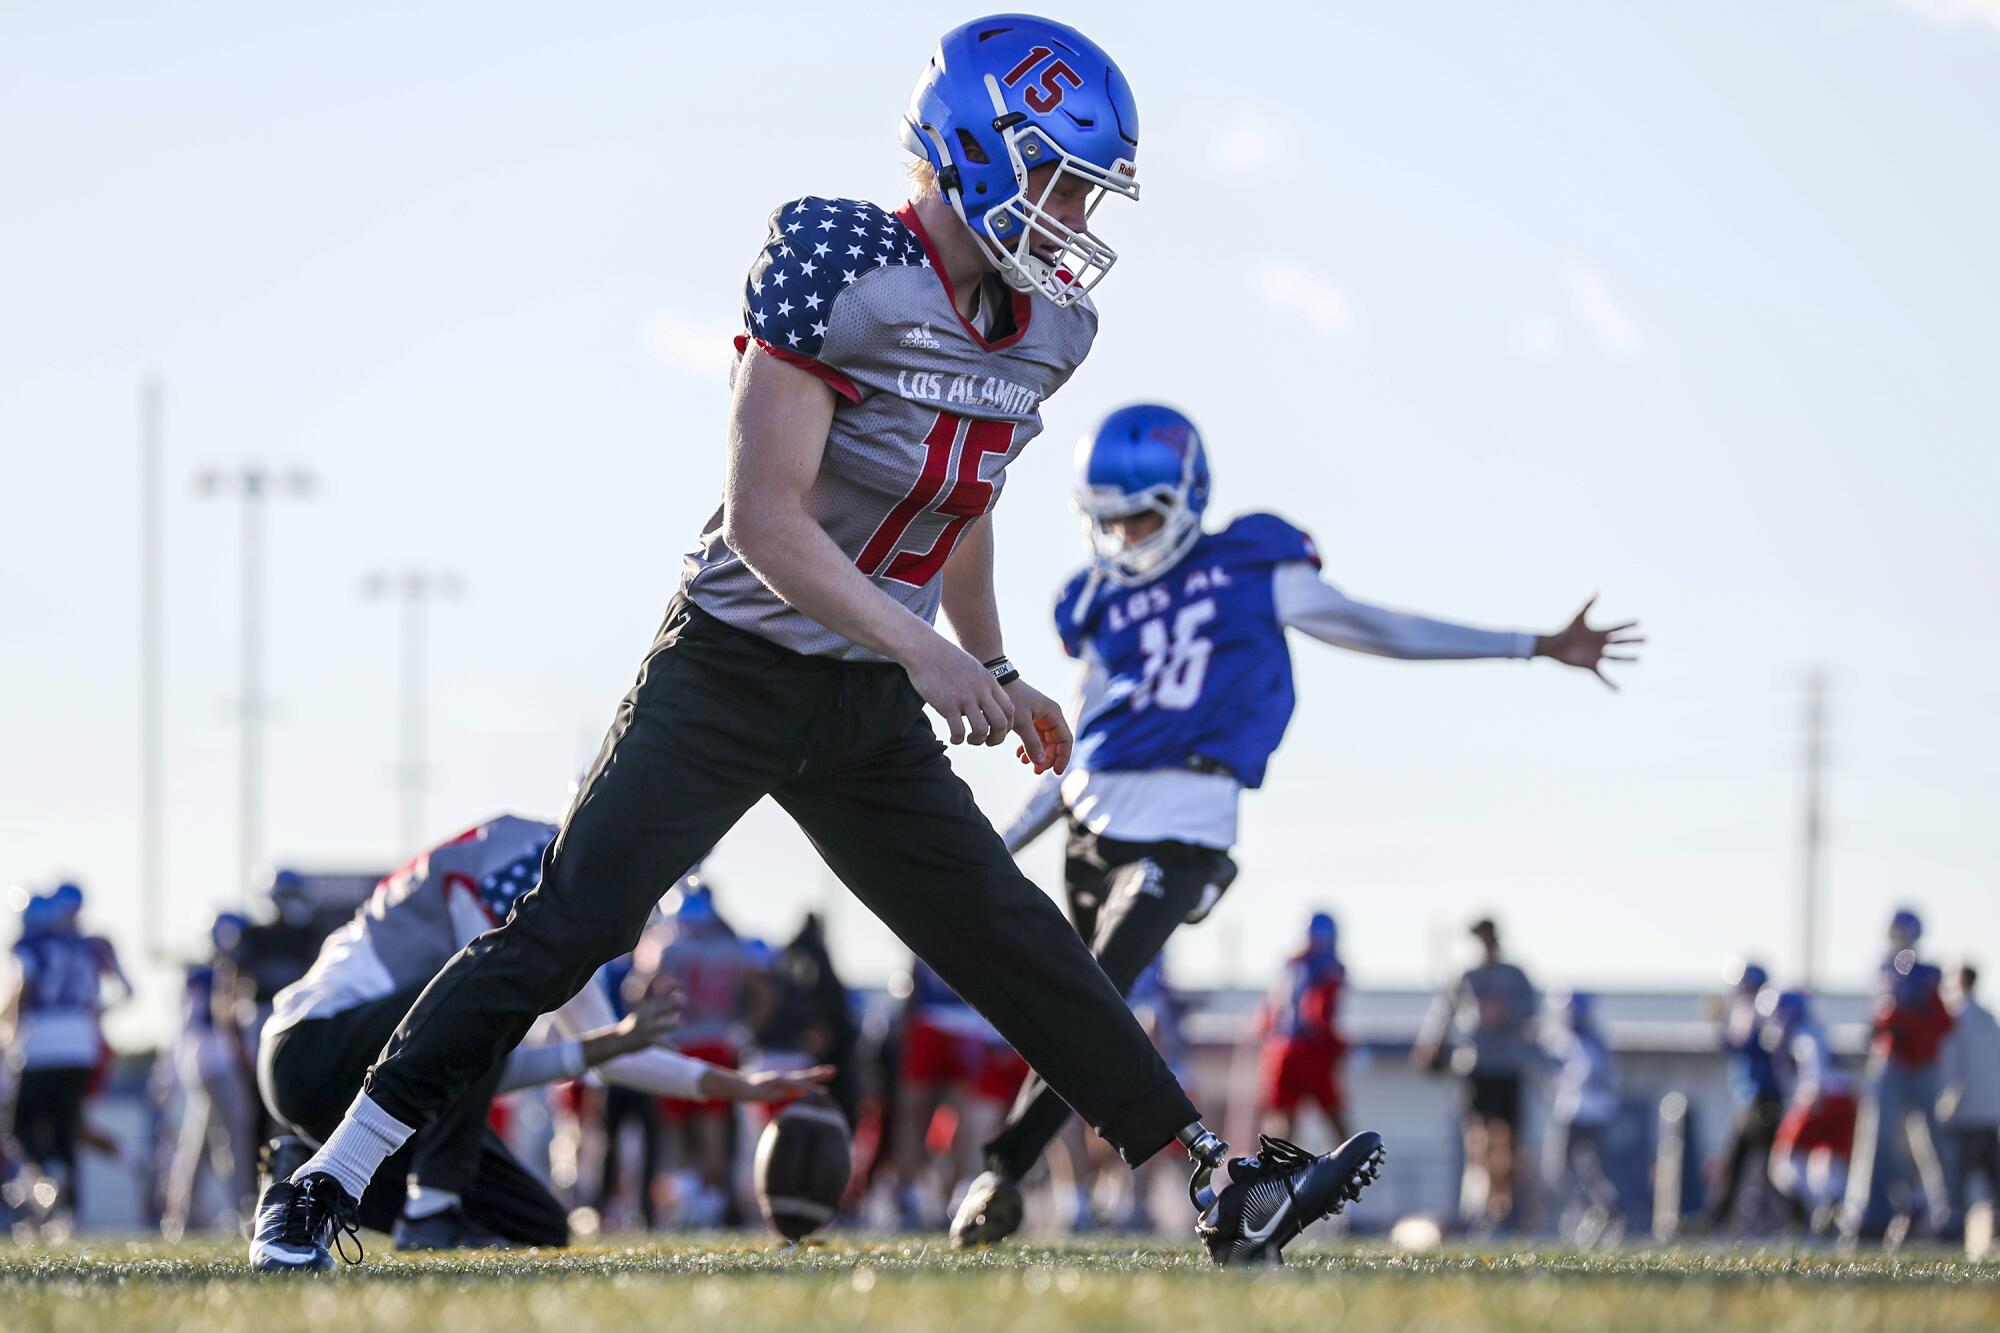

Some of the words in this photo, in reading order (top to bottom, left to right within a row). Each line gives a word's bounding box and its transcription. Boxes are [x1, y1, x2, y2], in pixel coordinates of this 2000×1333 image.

[1002, 46, 1084, 116] 15
[900, 338, 941, 349] adidas
[897, 370, 945, 400] LOS
[947, 374, 1041, 415] ALAMITO
[853, 410, 1018, 589] 15
[1108, 582, 1172, 634] LOS
